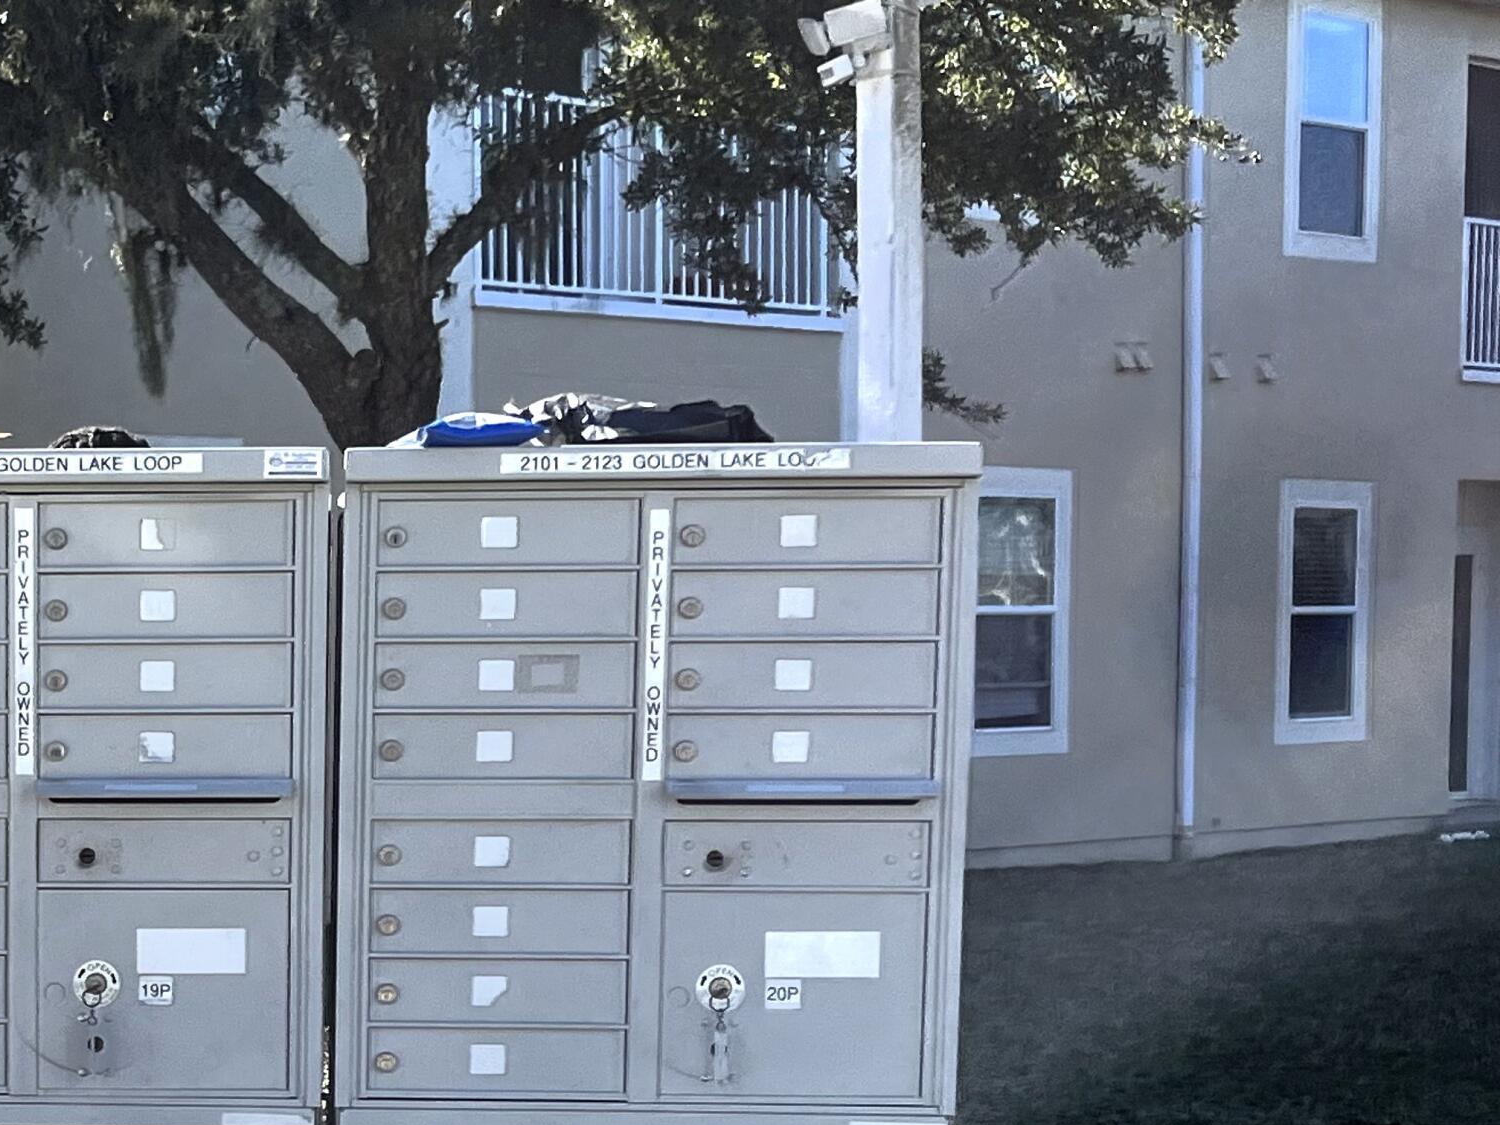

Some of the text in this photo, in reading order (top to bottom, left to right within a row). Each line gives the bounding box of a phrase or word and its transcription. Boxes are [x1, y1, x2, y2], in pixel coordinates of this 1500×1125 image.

[79, 456, 123, 471] LAKE
[134, 455, 182, 471] LOOP
[520, 456, 559, 471] 2101
[582, 455, 622, 471] 2123
[633, 454, 710, 470] GOLDEN
[720, 453, 766, 468] LAKE
[17, 529, 30, 756] PRIVATELY OWNED
[646, 531, 664, 762] PRIVATELY OWNED
[141, 983, 171, 998] 19P
[766, 986, 799, 1002] 20P
